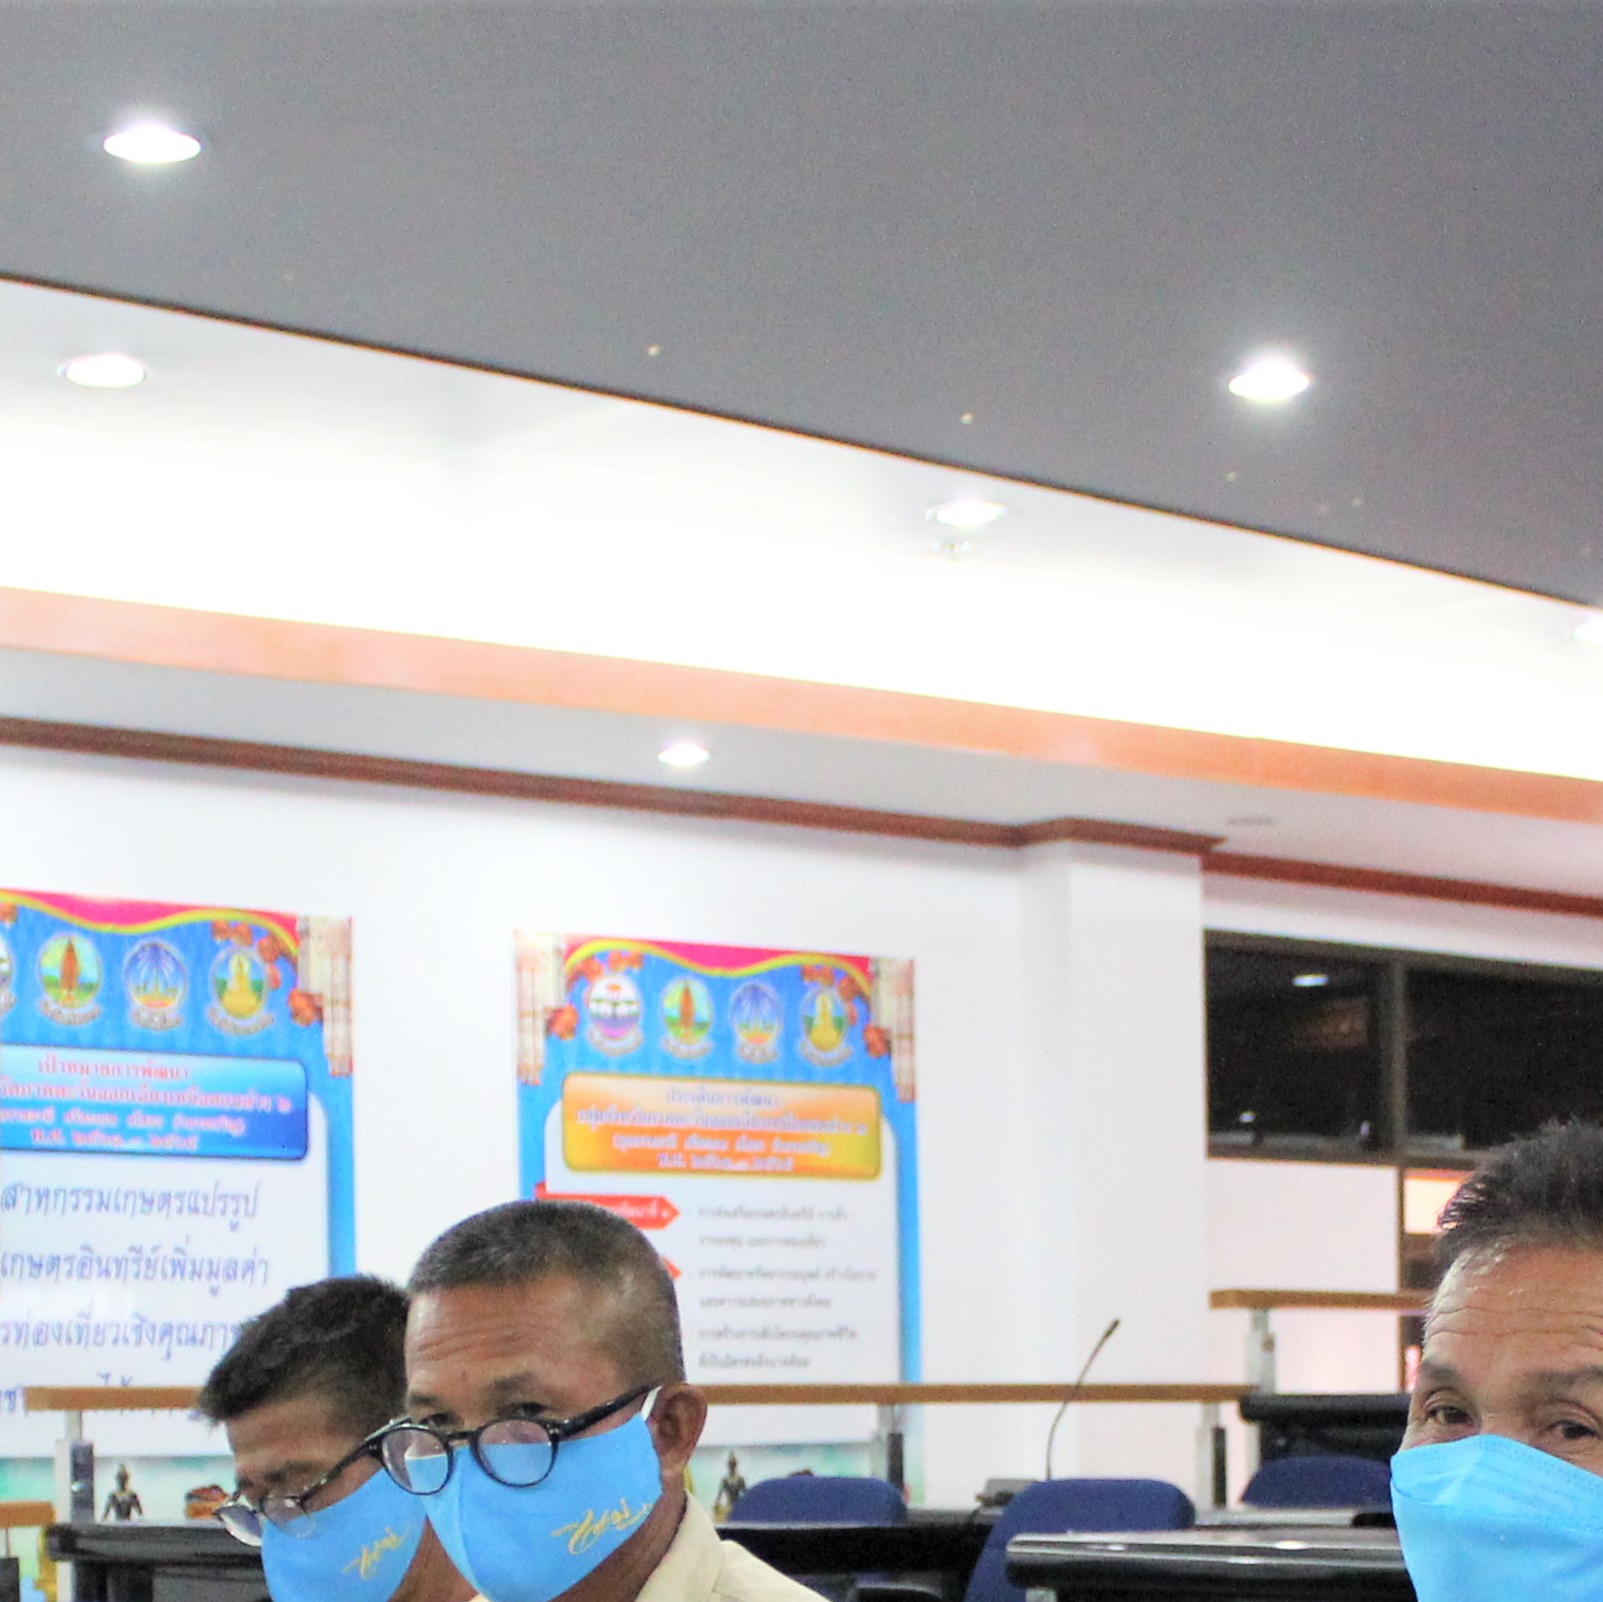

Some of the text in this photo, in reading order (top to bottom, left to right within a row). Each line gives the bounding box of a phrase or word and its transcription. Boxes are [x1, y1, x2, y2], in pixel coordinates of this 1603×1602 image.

[0, 1181, 261, 1232] สาหกรรมเกษตรแปรรูป
